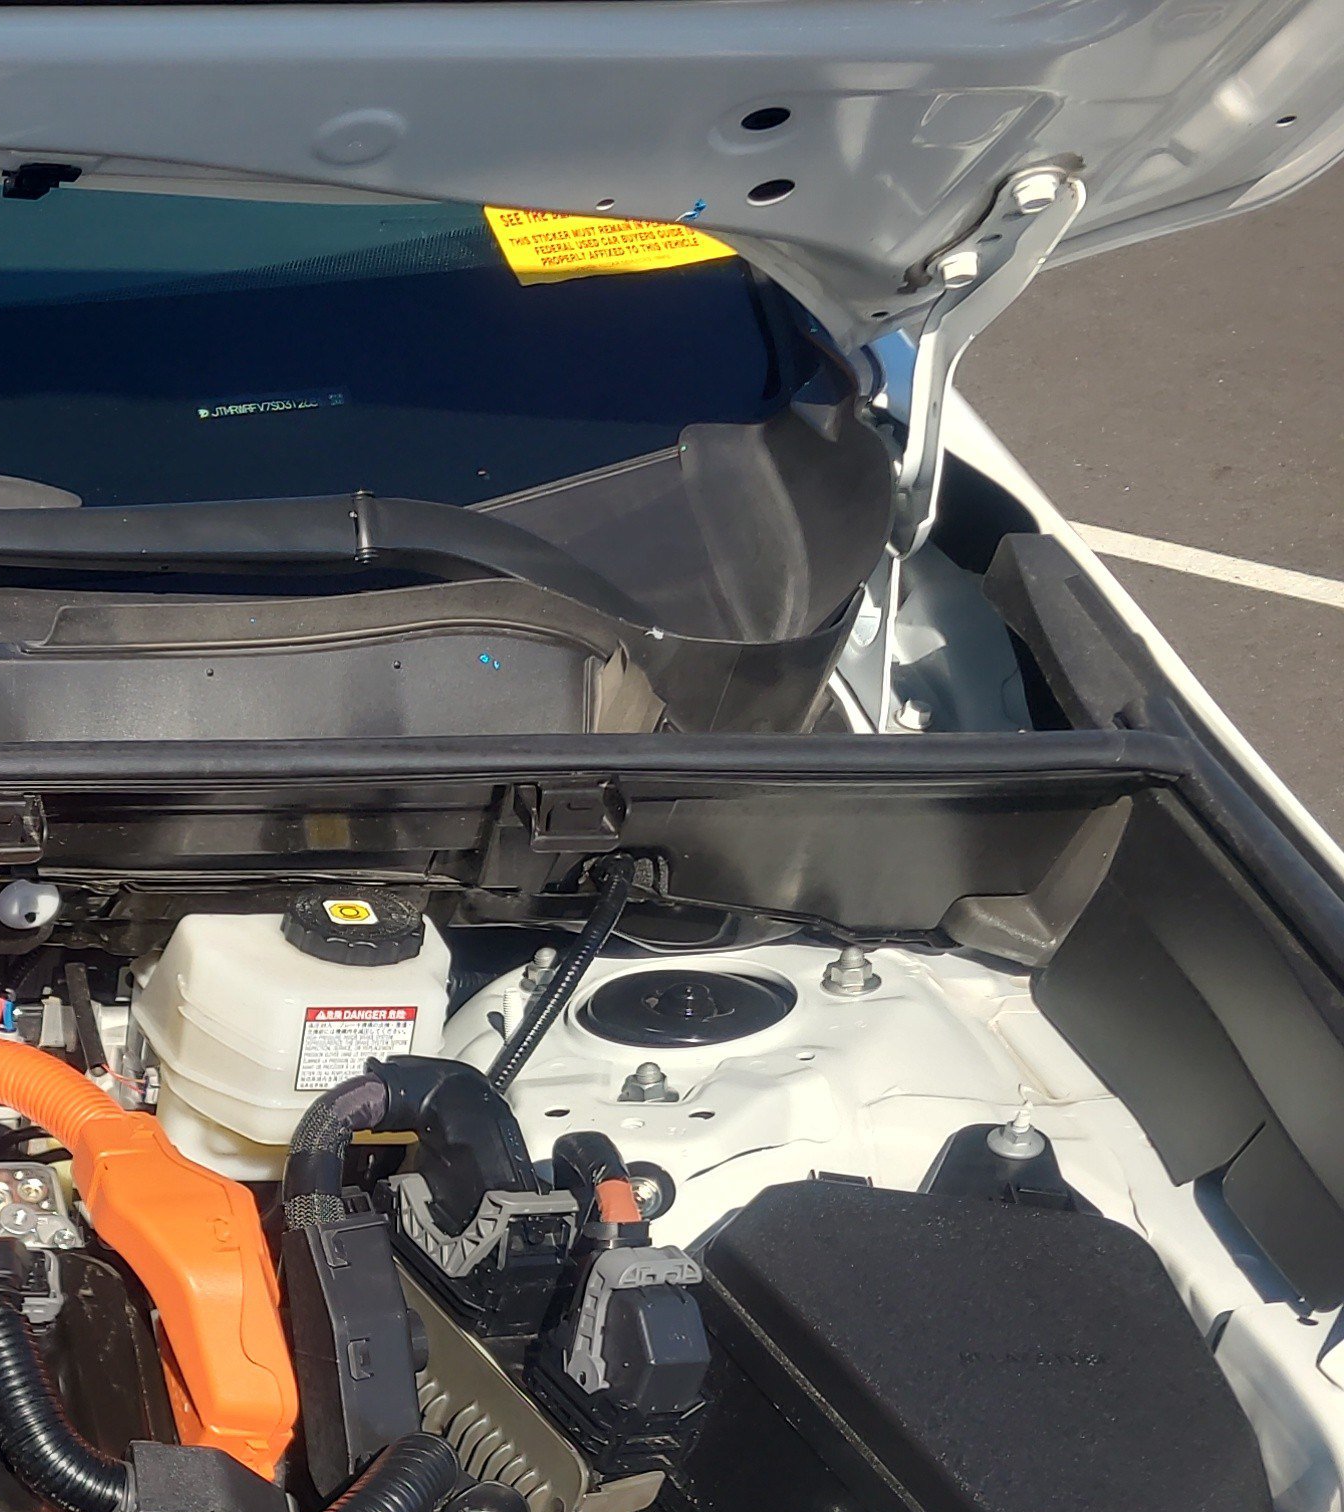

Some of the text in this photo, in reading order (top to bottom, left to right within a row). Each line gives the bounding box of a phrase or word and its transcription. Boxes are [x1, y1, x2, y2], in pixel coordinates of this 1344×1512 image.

[499, 212, 524, 227] SEE
[509, 236, 530, 248] THIS
[531, 230, 570, 244] STICKER
[572, 226, 597, 238] MUST
[597, 219, 633, 234] REMAIN
[534, 241, 575, 256] FEDERAL
[576, 237, 600, 250] USED
[602, 234, 620, 247] CAR
[621, 230, 657, 243] BUYERS
[657, 227, 684, 239] GUIDE
[541, 236, 700, 267] PROPERLY AFFIXED TO THIS VEHICLE
[343, 1009, 387, 1020] DANGER
